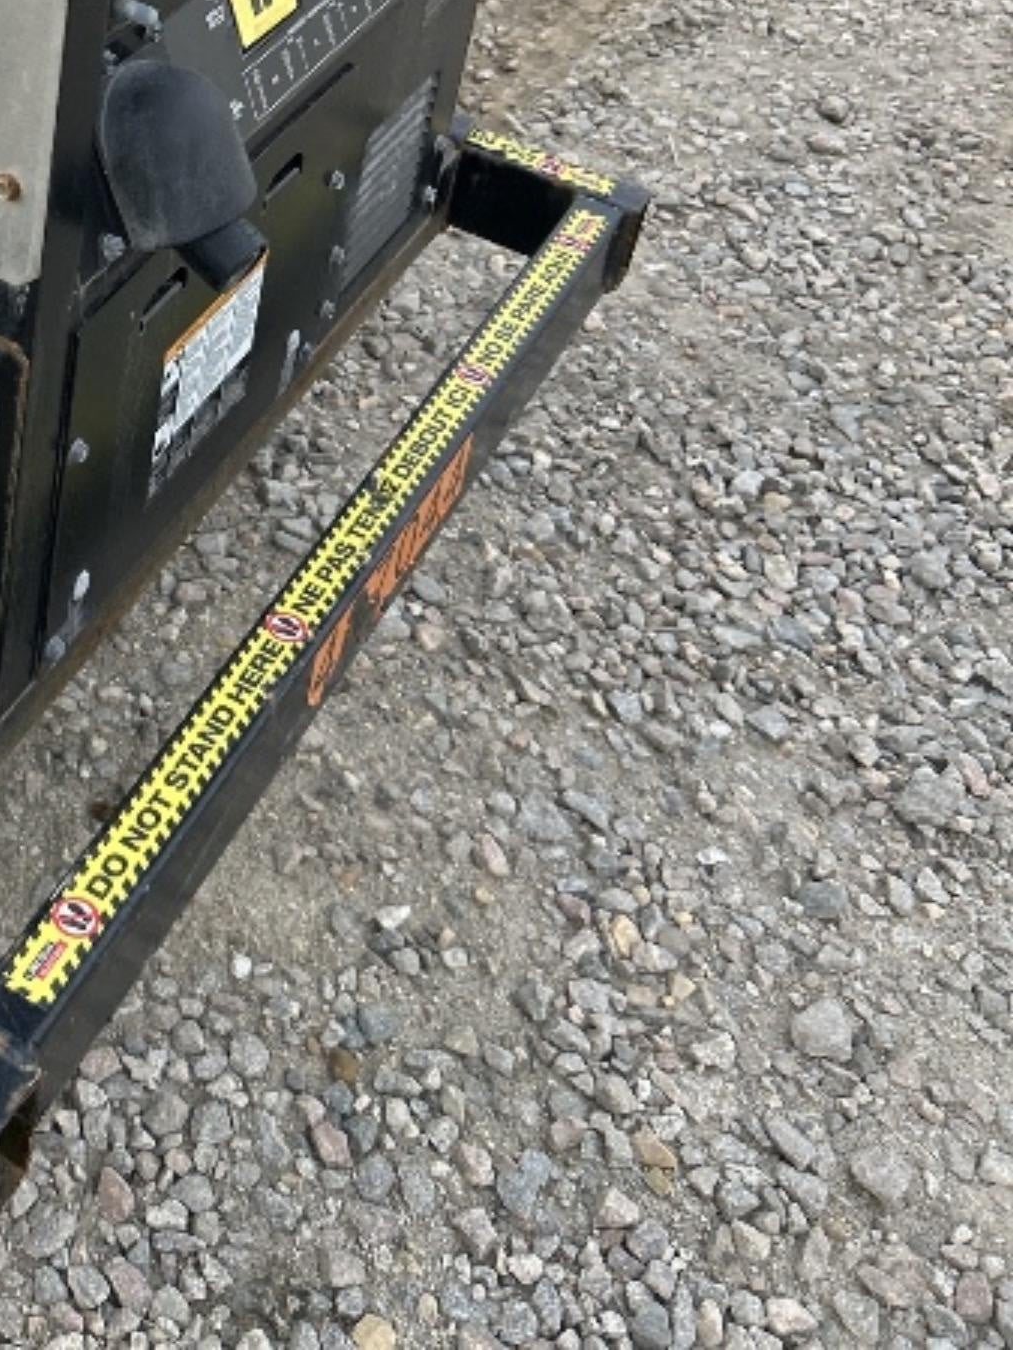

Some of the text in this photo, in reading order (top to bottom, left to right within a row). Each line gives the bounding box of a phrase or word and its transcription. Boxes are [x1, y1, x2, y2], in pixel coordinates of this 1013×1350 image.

[88, 851, 129, 900] DO
[120, 790, 173, 851] NOT
[164, 706, 235, 791] STAND
[231, 638, 285, 707] HERE
[293, 578, 325, 616] NE
[316, 541, 357, 584] PAS
[391, 408, 454, 479] DEBOUT
